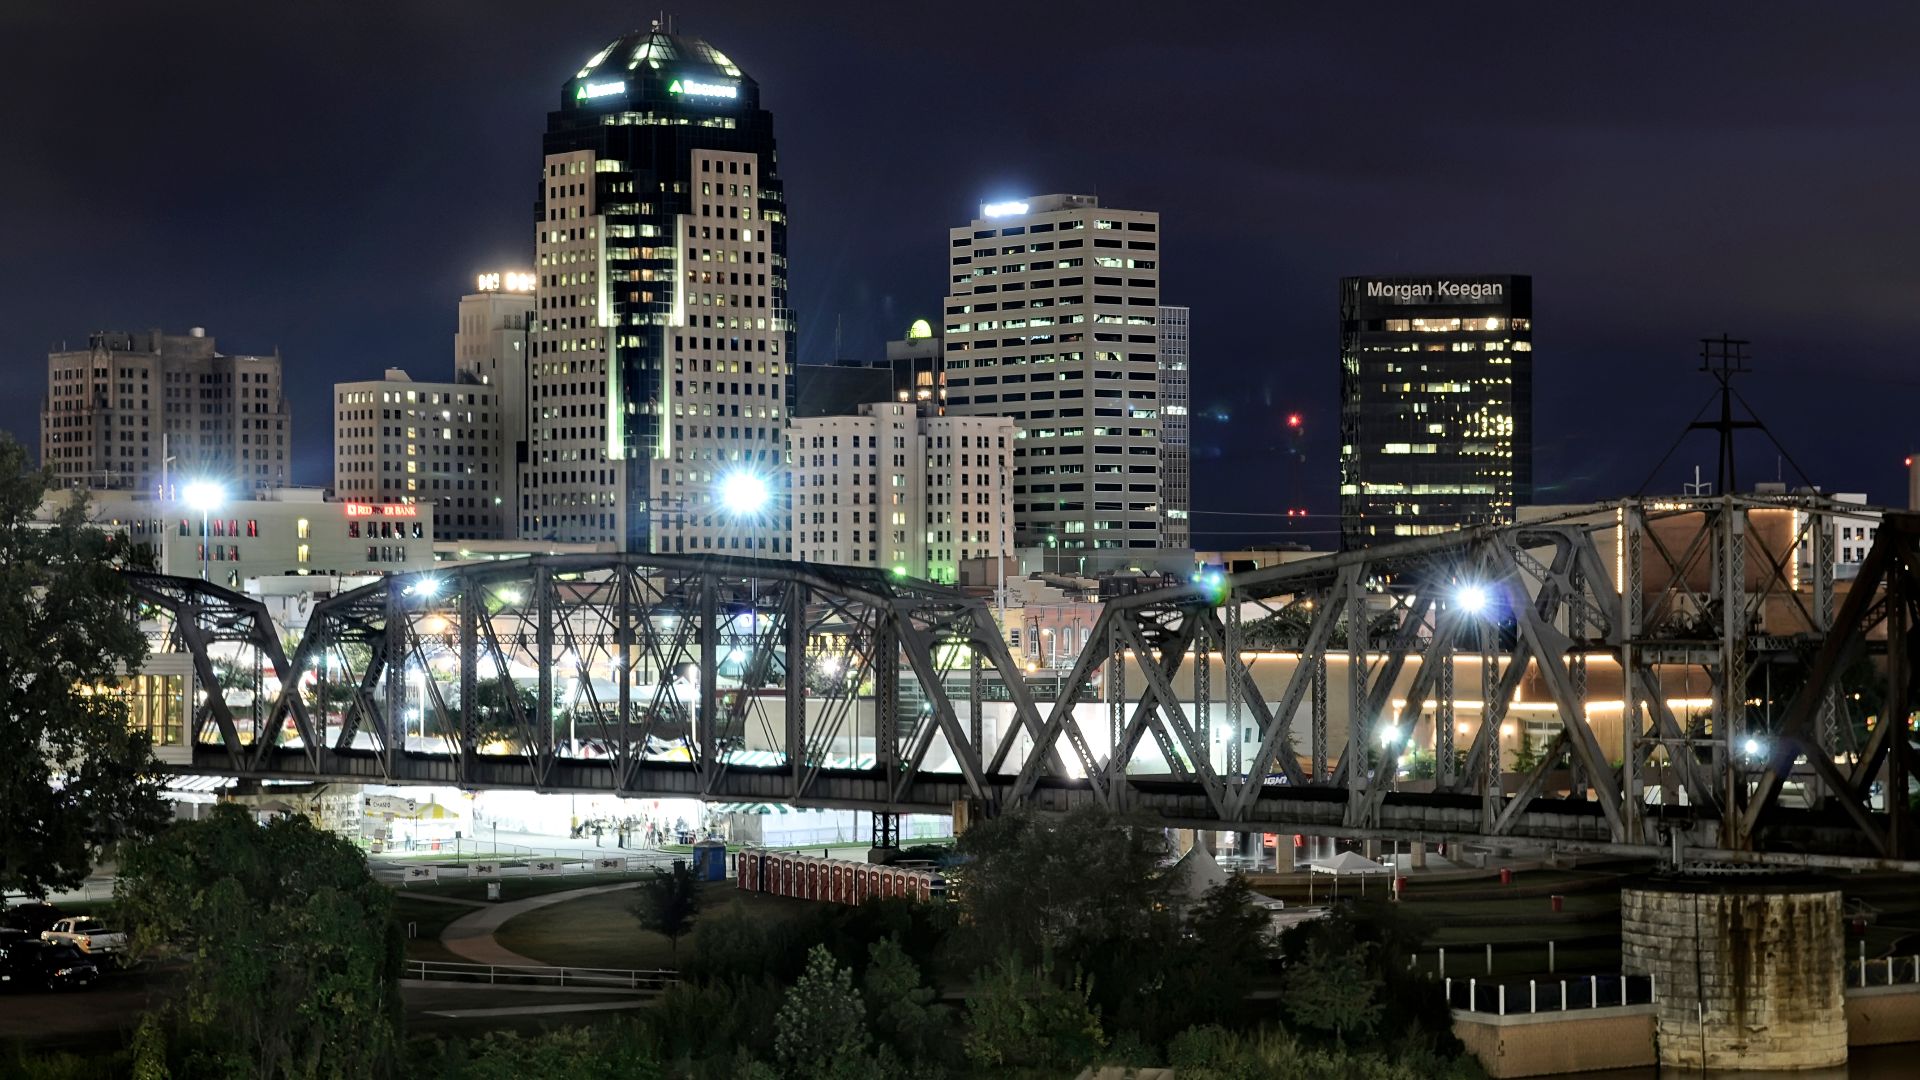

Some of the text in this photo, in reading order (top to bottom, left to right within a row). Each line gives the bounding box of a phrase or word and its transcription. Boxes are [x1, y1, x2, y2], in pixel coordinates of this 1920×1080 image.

[1367, 281, 1503, 300] Morgan Keegan
[357, 505, 373, 516] RED
[395, 505, 416, 516] BANK
[1263, 776, 1287, 785] IGHT
